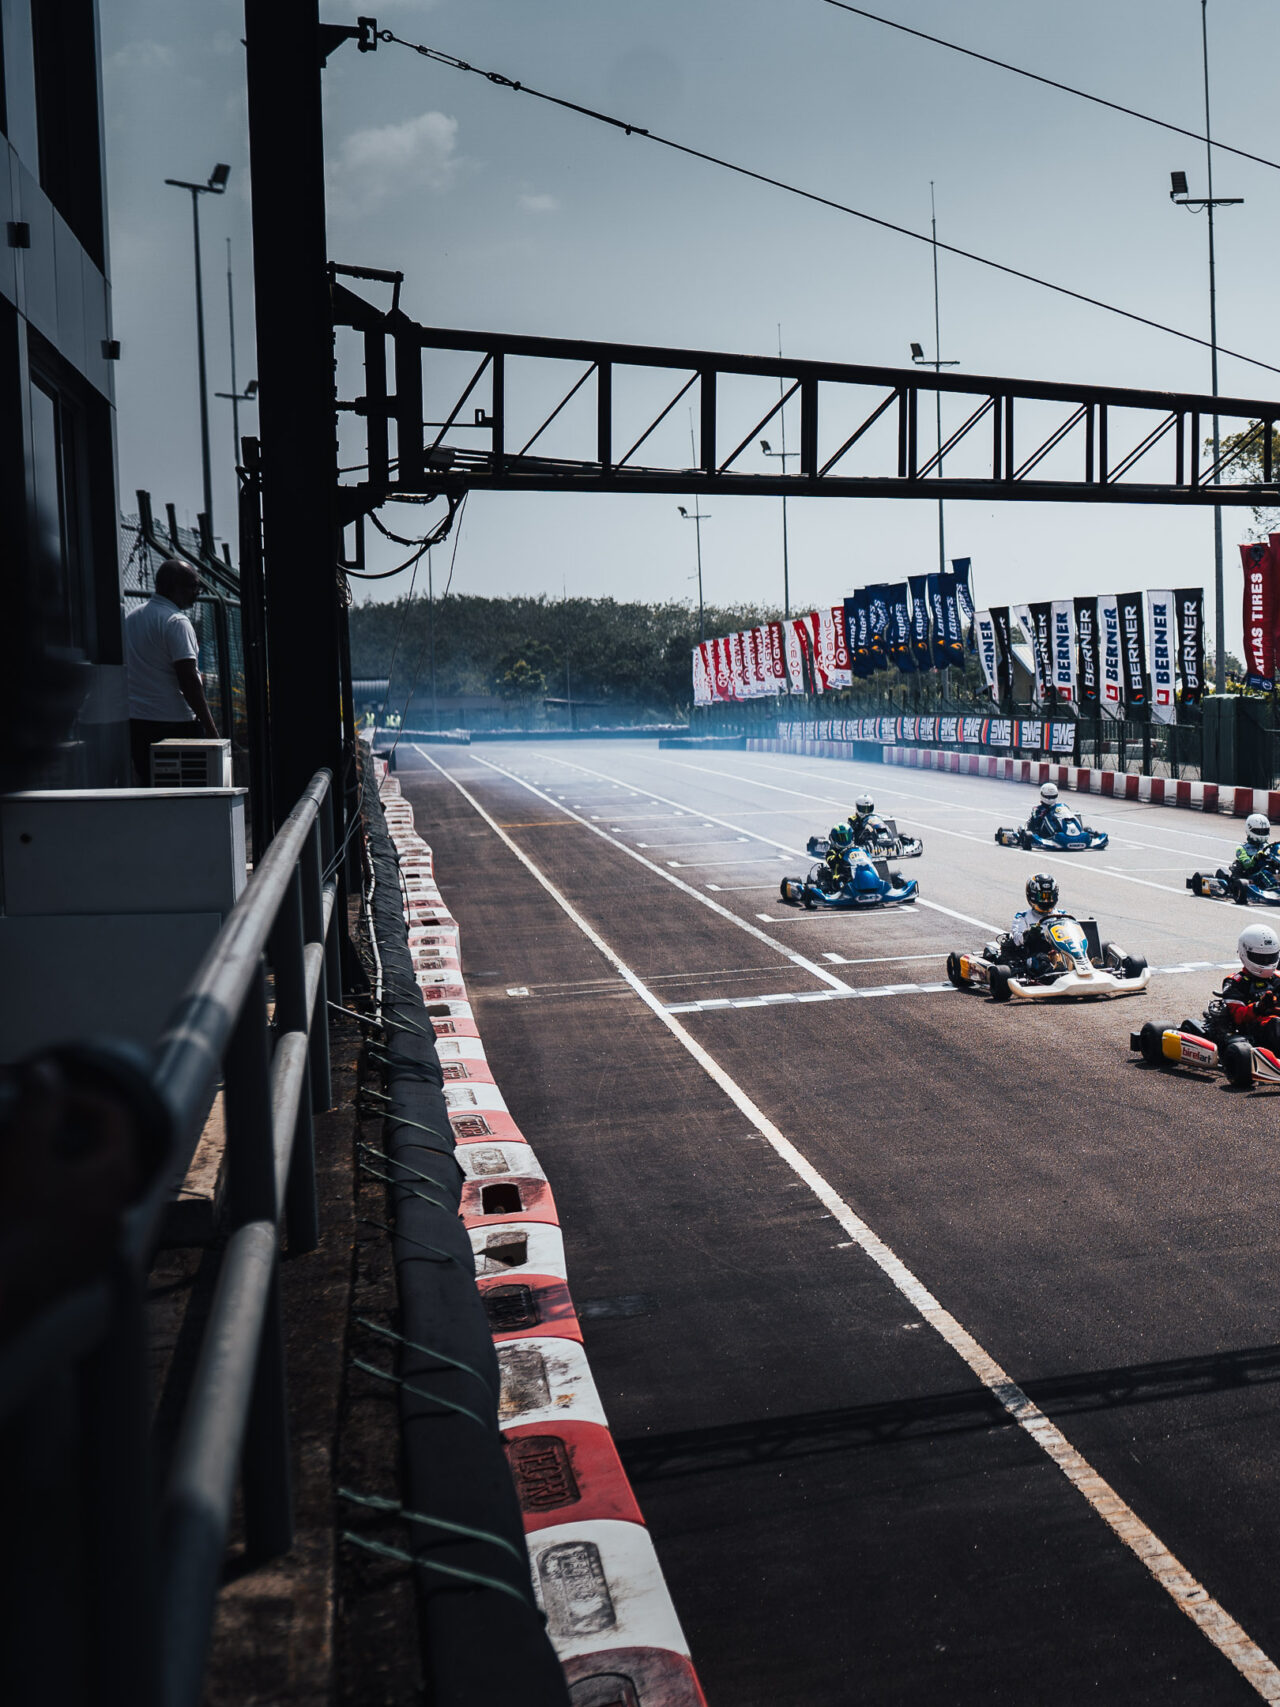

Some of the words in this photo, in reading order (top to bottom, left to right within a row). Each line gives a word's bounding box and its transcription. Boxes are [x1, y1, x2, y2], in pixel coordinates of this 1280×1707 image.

[834, 610, 846, 648] GWM
[1250, 572, 1263, 621] TIRES
[772, 626, 780, 659] GWM
[1056, 612, 1071, 683] BERNER
[1079, 608, 1095, 688] BERNER
[1103, 607, 1119, 682] BERNER
[1124, 605, 1143, 690] BERNER
[1152, 603, 1170, 684] BERNER
[1182, 600, 1199, 689] BERNER
[1250, 627, 1265, 675] ATLAS
[1182, 1047, 1212, 1064] birelart
